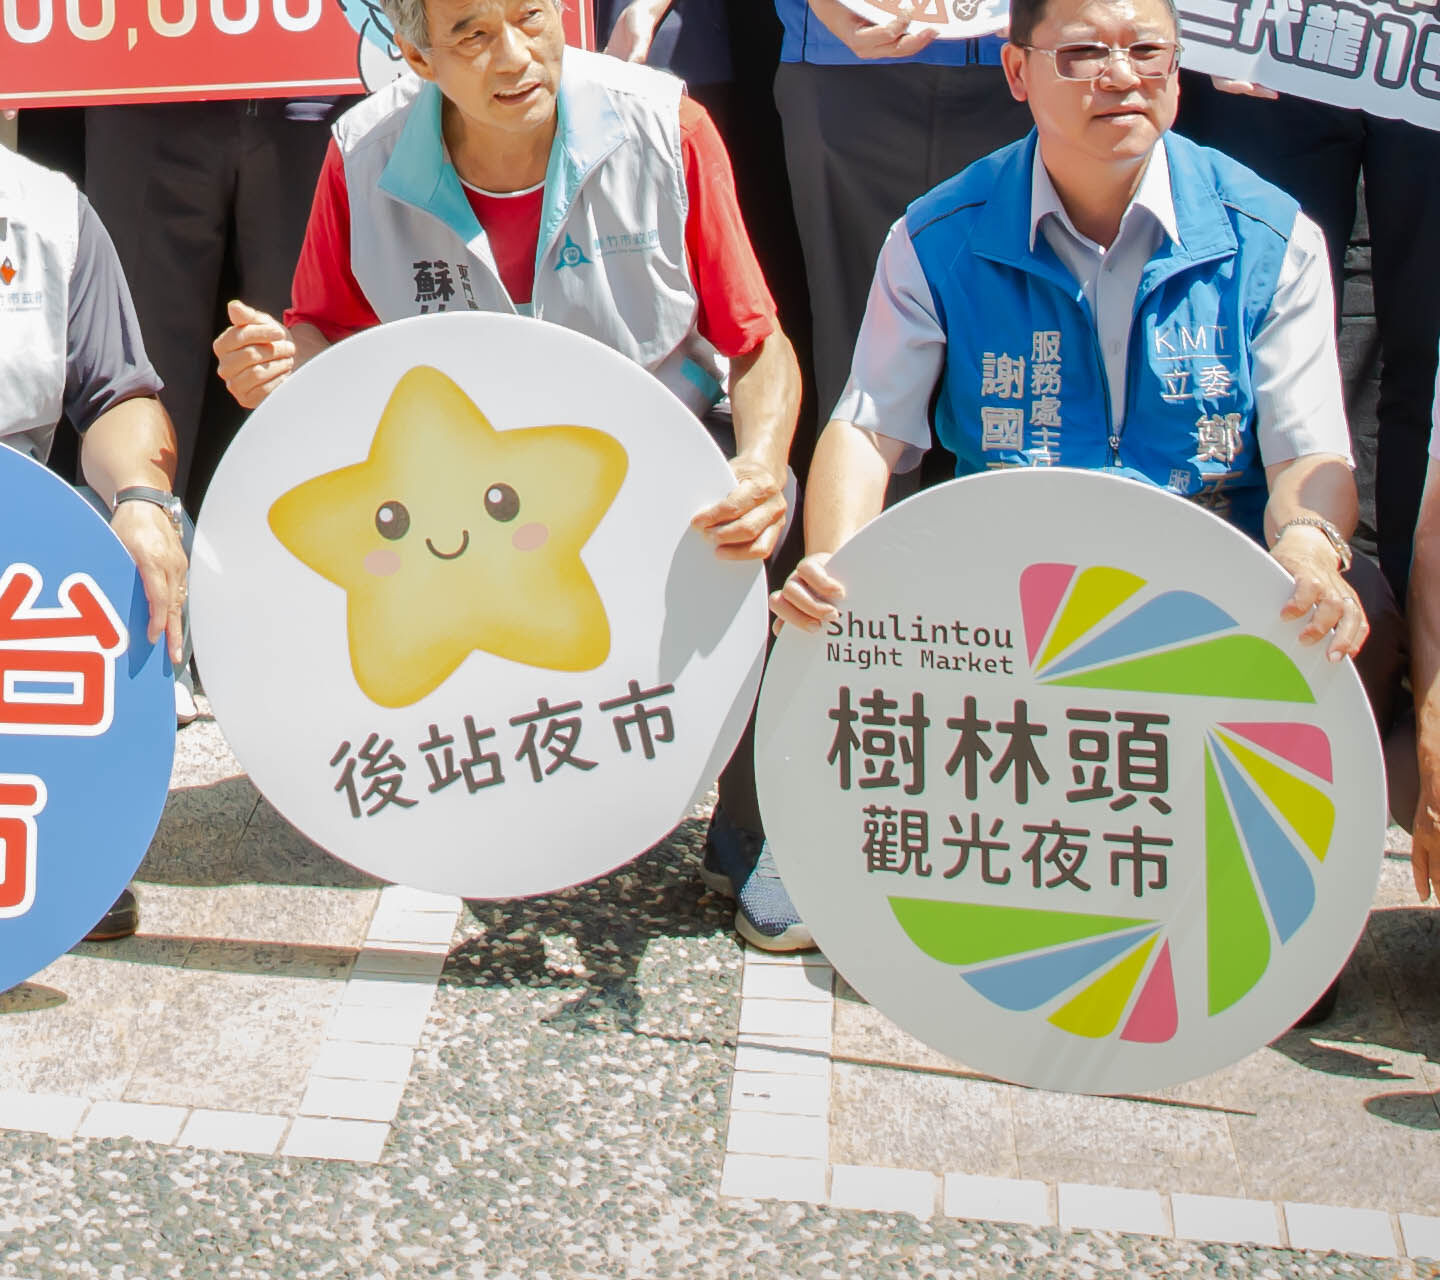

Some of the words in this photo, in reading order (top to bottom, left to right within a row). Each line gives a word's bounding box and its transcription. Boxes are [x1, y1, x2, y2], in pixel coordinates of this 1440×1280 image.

[1154, 325, 1230, 355] KMT
[981, 351, 1024, 468] 謝國
[1162, 364, 1232, 401] 立委
[827, 611, 1014, 649] Shulintou
[827, 642, 903, 670] Night
[920, 649, 1014, 675] Market
[330, 678, 679, 822] 後站夜市
[827, 686, 1173, 816] 樹林頭
[862, 804, 1175, 898] 觀光夜市
